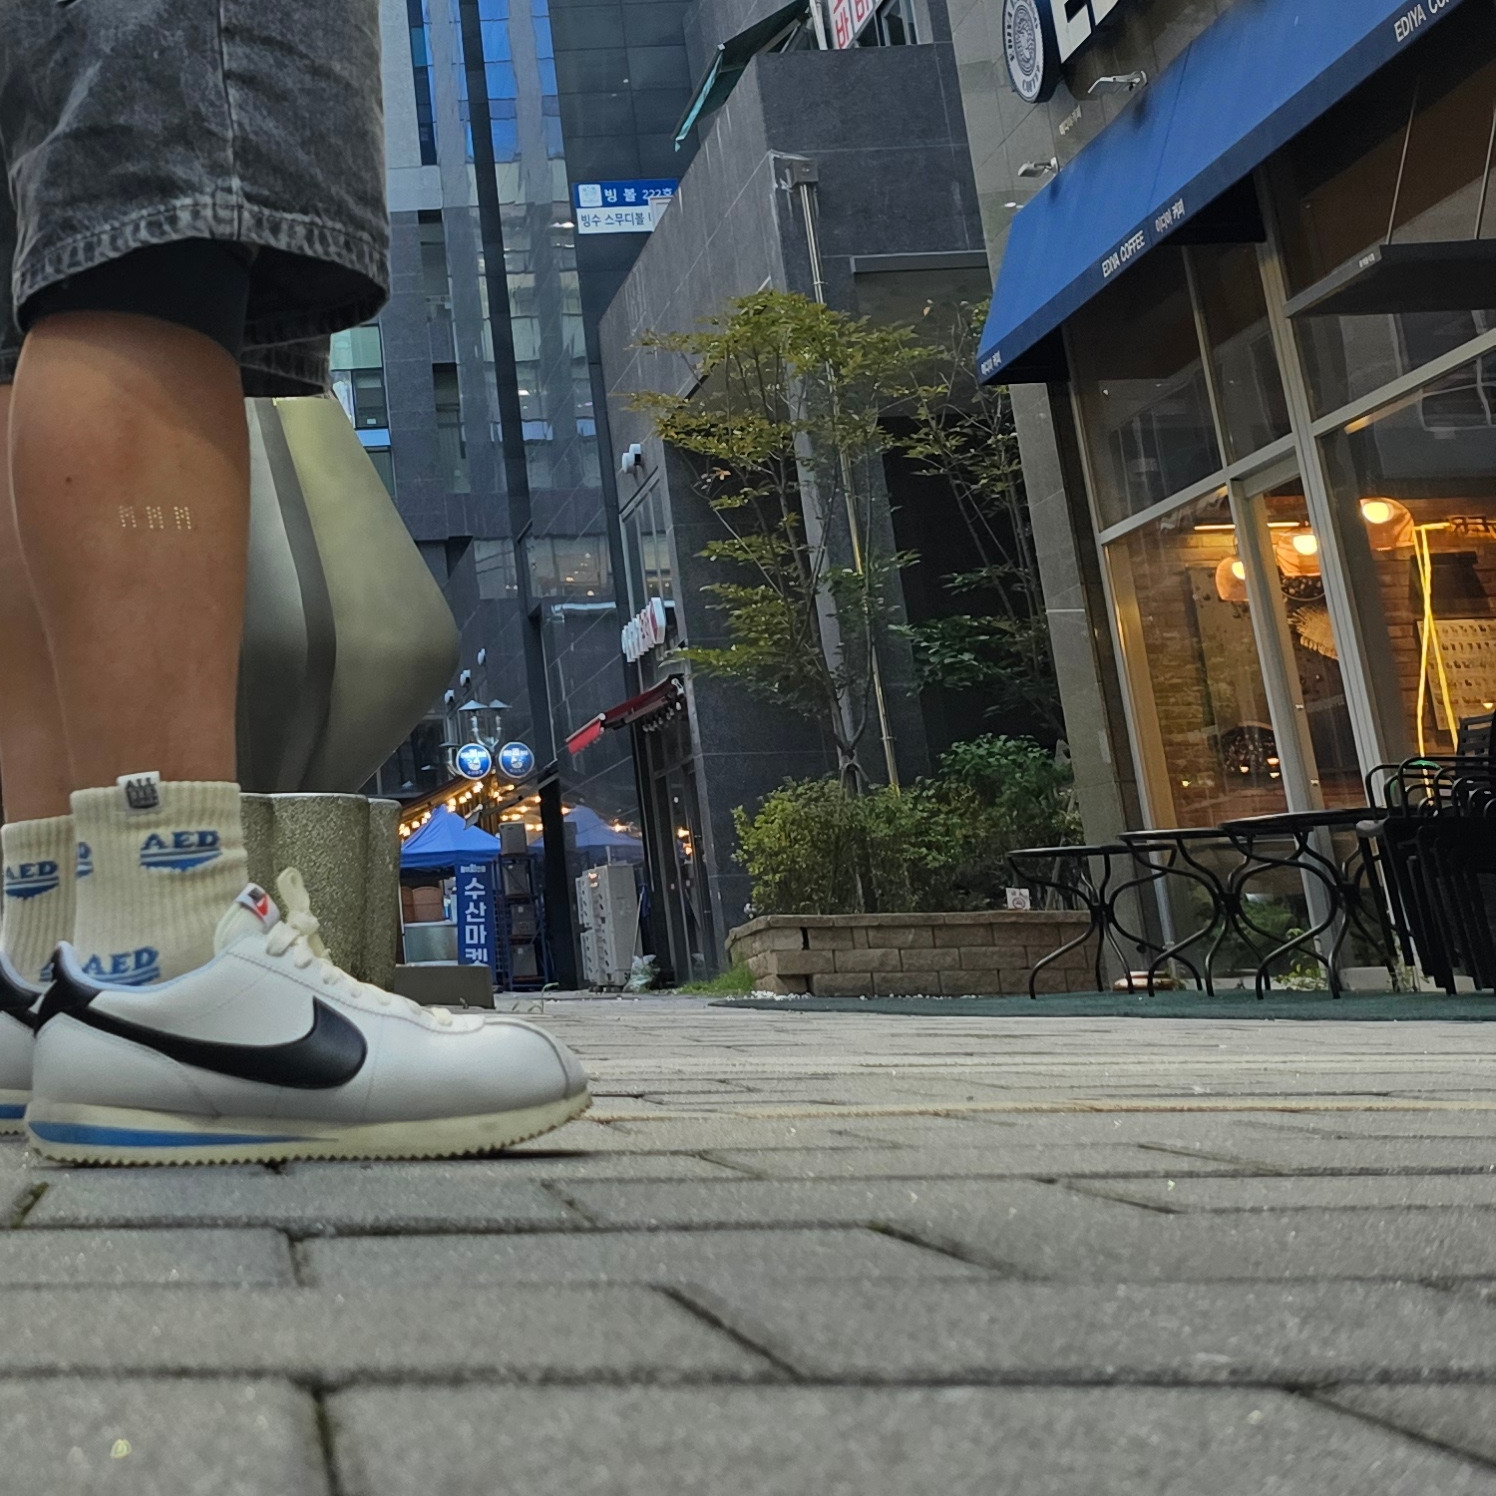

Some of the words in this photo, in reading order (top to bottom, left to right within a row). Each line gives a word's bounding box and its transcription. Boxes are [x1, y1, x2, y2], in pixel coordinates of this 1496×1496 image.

[1393, 4, 1427, 42] EDIYA
[580, 213, 602, 228] 빙수
[604, 212, 645, 226] 스무디볼
[1102, 255, 1121, 278] EDIYA
[1120, 229, 1146, 256] COFFEE
[141, 830, 221, 852] AED
[5, 860, 58, 880] AED
[464, 877, 488, 965] 수산마켓
[81, 945, 160, 976] AED
